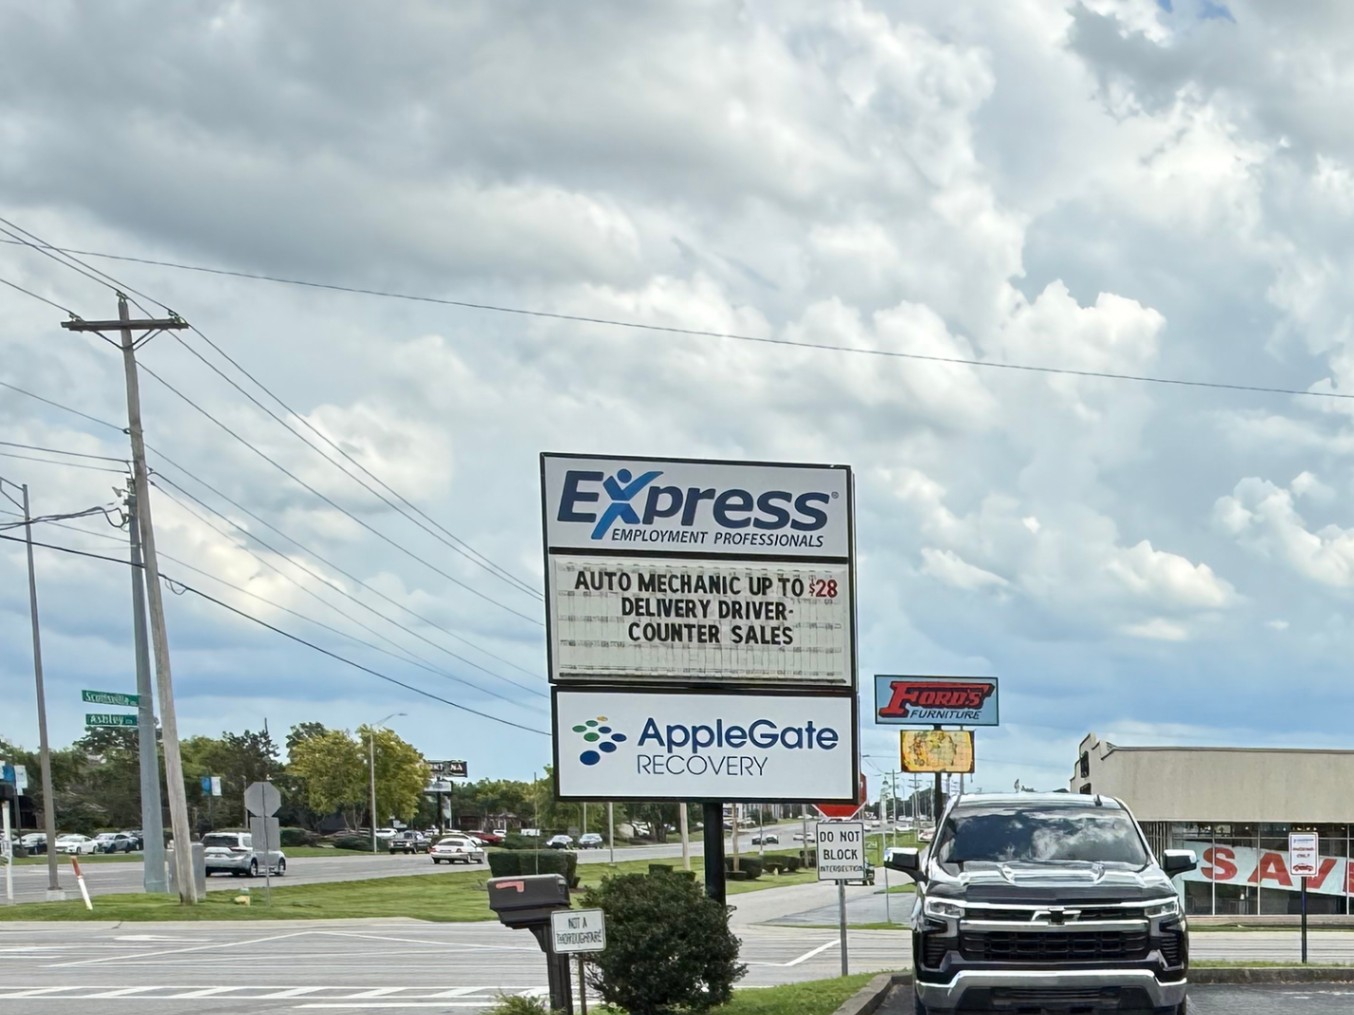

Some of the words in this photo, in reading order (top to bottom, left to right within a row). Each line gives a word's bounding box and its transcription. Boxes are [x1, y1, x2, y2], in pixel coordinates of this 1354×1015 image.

[611, 528, 708, 545] EMPLOYMENT
[714, 532, 825, 548] PROFESSIONALS
[575, 571, 632, 593] AUTO
[638, 573, 741, 595] MECHANIC
[750, 576, 773, 596] UP
[778, 577, 805, 597] TO
[808, 579, 838, 598] $28
[621, 597, 711, 619] DELIVERY
[628, 622, 720, 644] COUNTER
[731, 626, 794, 645] SALES
[879, 681, 995, 718] FORD'S
[910, 709, 982, 720] FURNITURE
[637, 717, 839, 754] AppleGate
[637, 754, 769, 777] RECOVERY
[820, 831, 834, 842] DO
[840, 831, 861, 842] NOT
[823, 849, 858, 860] BLOCK
[820, 865, 863, 873] INTERSECTION
[567, 918, 580, 929] NOT
[582, 917, 588, 929] A
